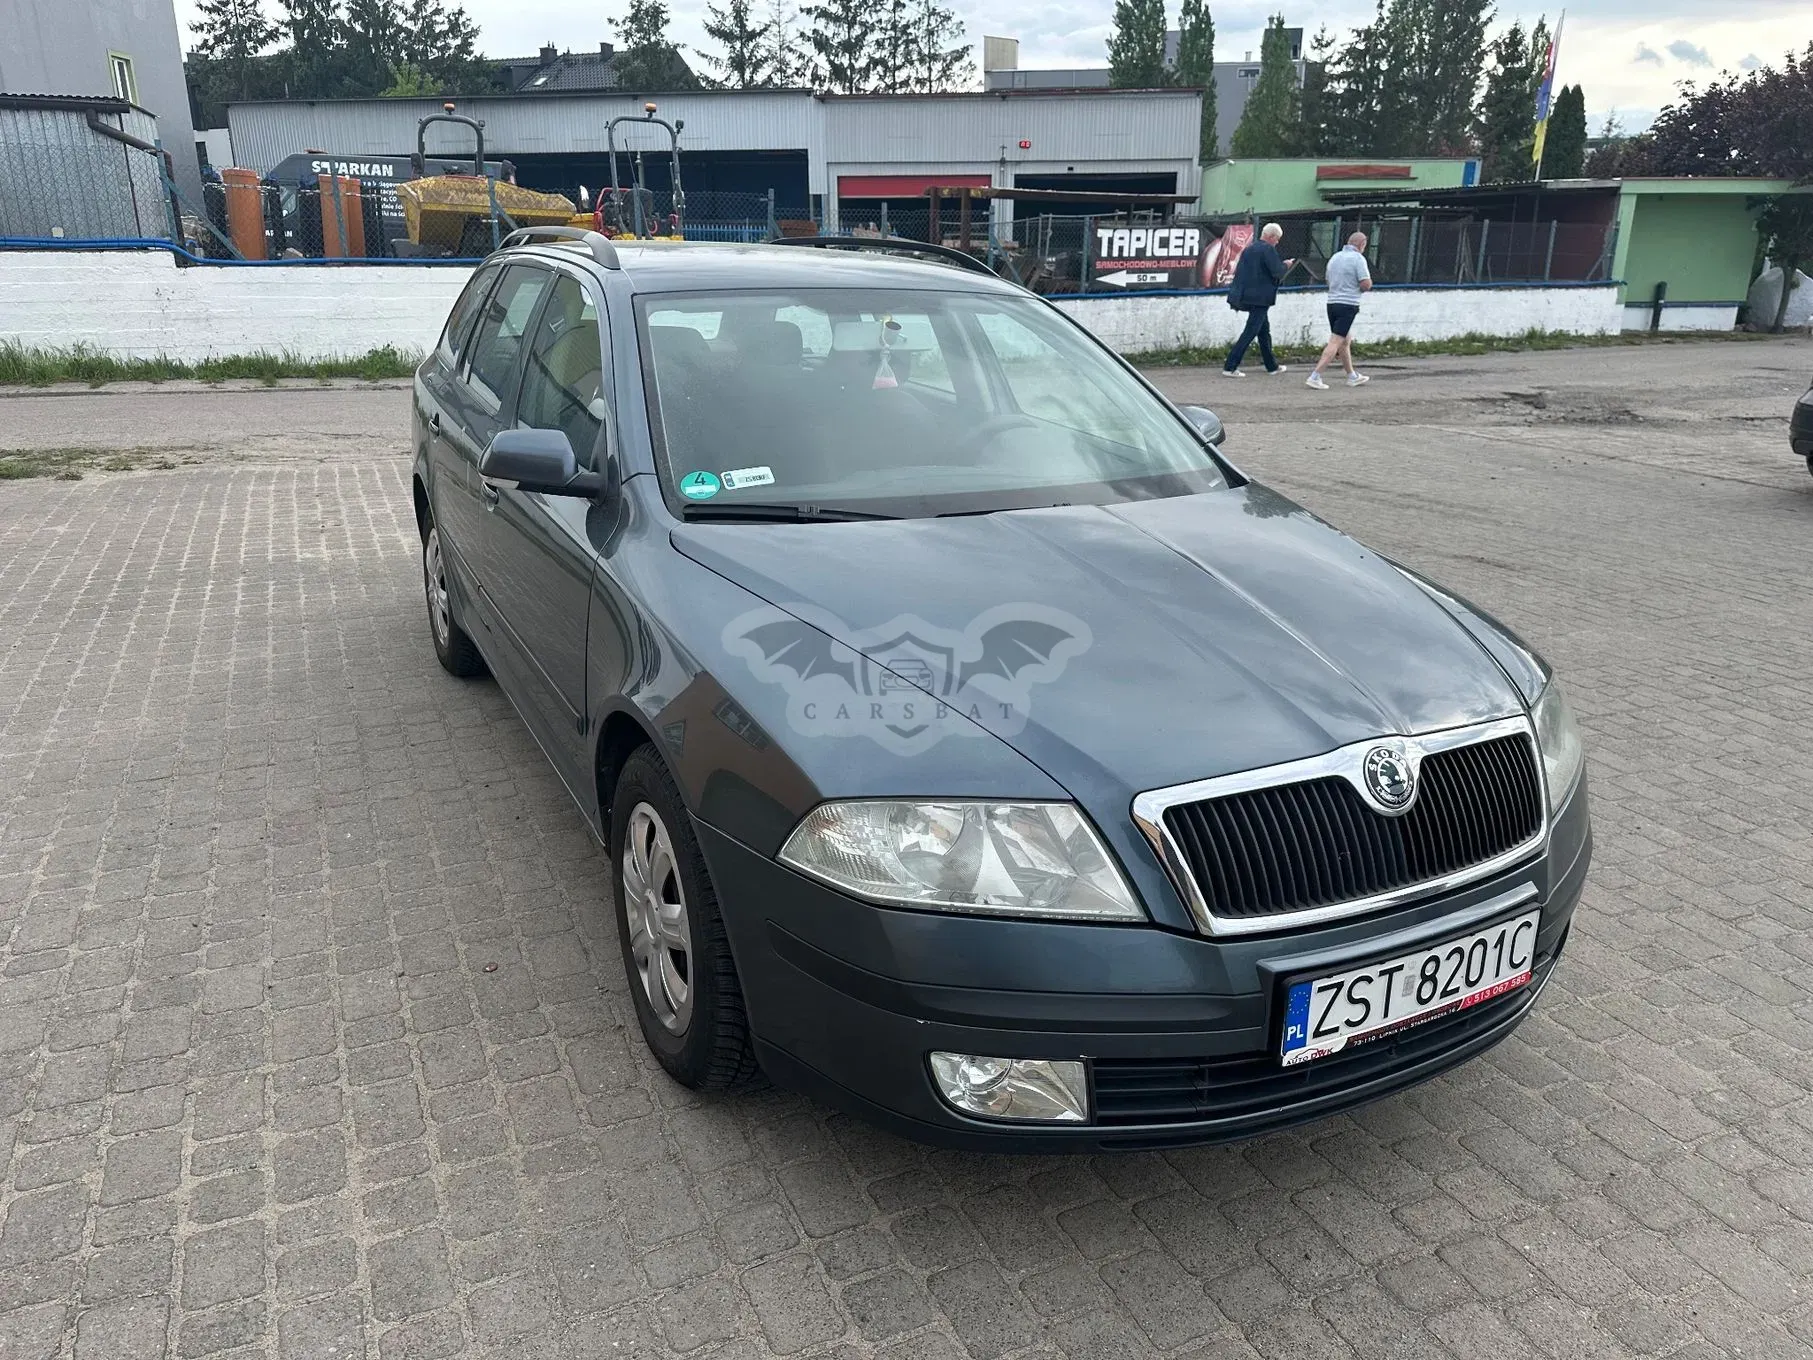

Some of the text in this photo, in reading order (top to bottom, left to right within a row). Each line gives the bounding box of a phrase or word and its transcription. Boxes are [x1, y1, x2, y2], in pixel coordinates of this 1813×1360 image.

[1097, 228, 1200, 257] TAPICER
[1096, 260, 1197, 269] SAMOCHODOWO-MEBLOWY
[695, 472, 706, 485] 4
[1312, 963, 1404, 1040] ZST
[1415, 920, 1533, 1006] 8201C
[1474, 975, 1526, 1002] 513 067 585
[1287, 1024, 1304, 1041] PL
[1286, 1047, 1334, 1066] AUTO DWK
